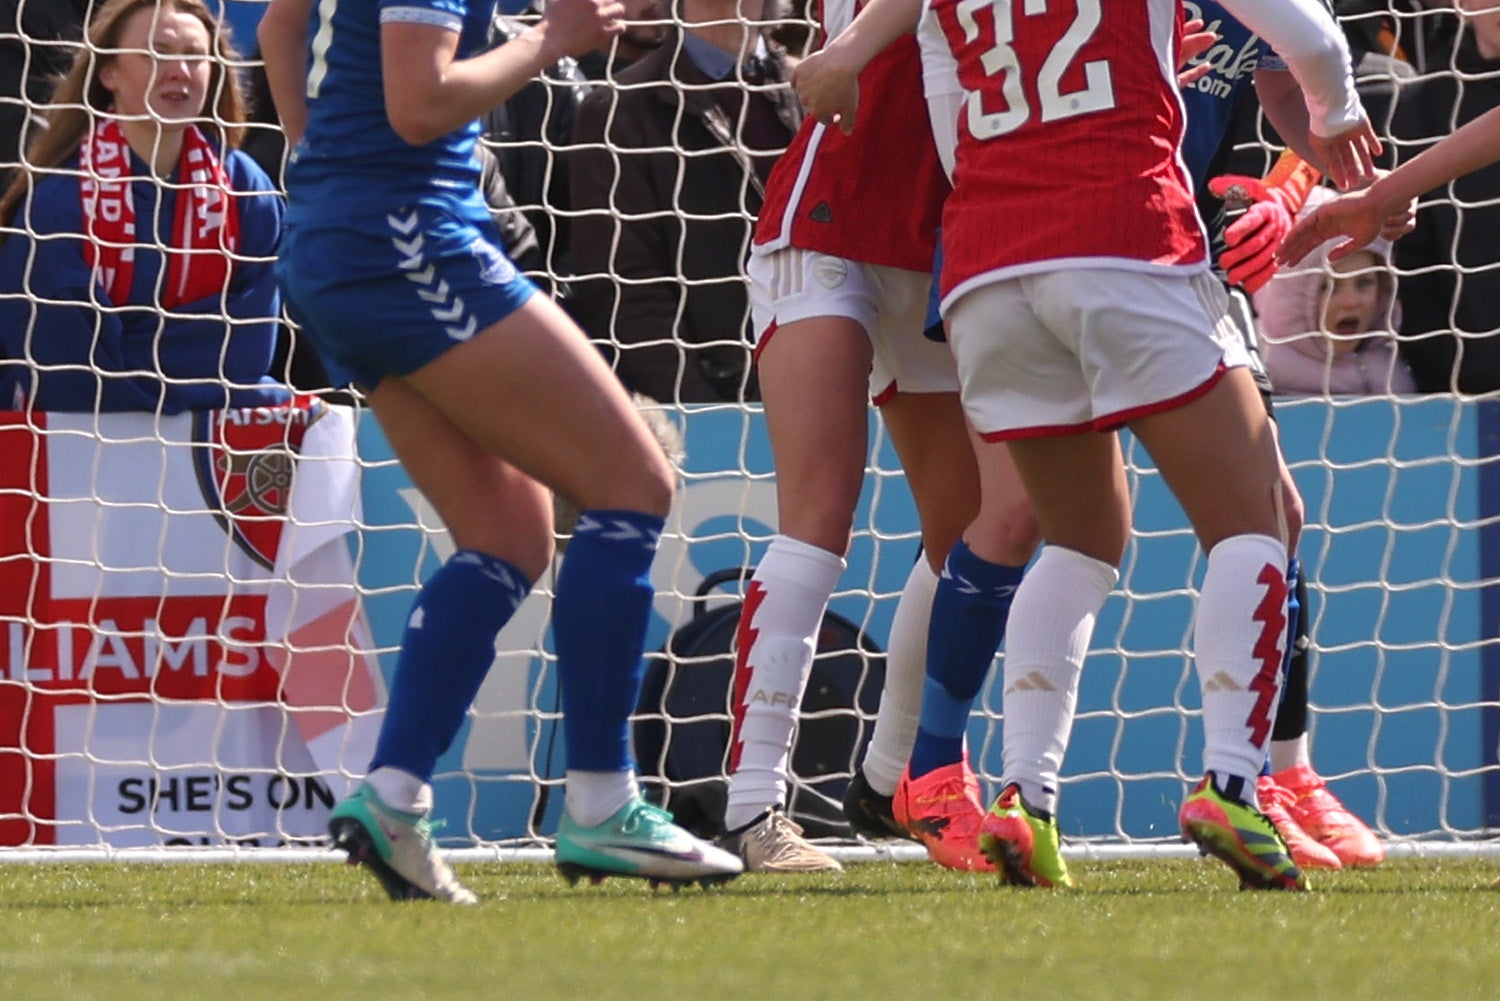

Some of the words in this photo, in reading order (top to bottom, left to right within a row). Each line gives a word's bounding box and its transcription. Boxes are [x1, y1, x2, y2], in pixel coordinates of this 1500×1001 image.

[0, 615, 262, 684] LIAMS
[118, 773, 254, 814] SHE'S
[267, 773, 335, 812] ON
